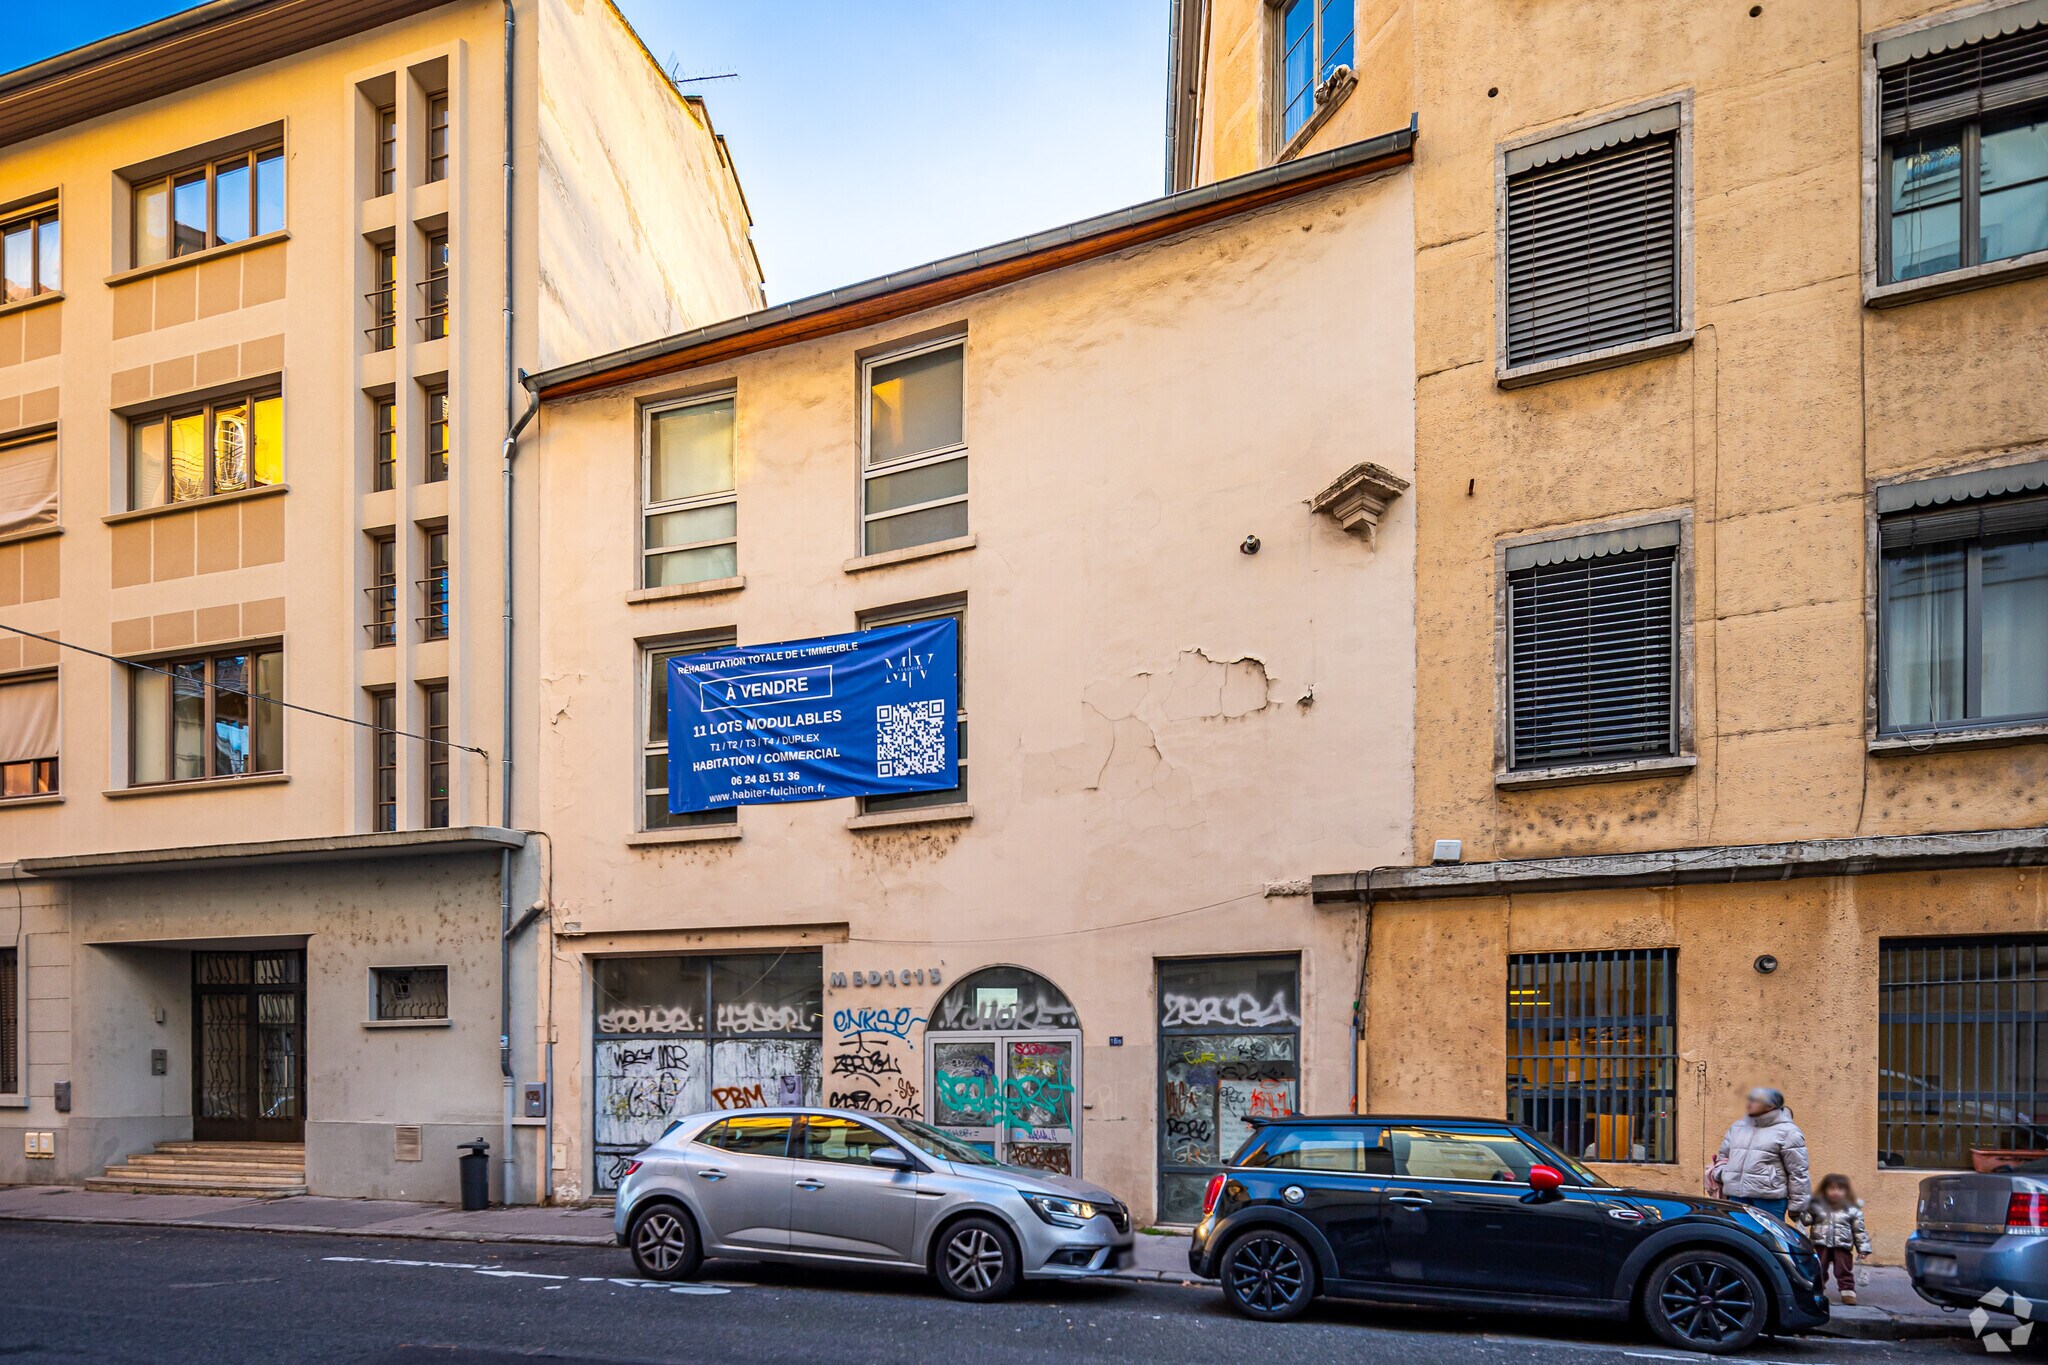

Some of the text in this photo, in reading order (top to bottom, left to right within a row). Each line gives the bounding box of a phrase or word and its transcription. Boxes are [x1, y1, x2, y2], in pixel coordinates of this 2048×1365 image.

[677, 641, 859, 675] RÉHABILITATION TOTALE DE L'IMMEUBLE
[725, 676, 809, 701] À VENDRE
[693, 709, 842, 738] 11 LOTS MODULABLES
[710, 742, 721, 752] T1
[727, 740, 738, 750] T2
[745, 738, 757, 748] T3
[762, 736, 774, 746] T4
[782, 733, 820, 745] DUPLEX
[693, 754, 755, 772] HABITATION
[764, 747, 841, 763] COMMERCIAL
[731, 771, 800, 786] 06 24 81 51 36
[709, 783, 826, 803] www.habiter-fulchiron.fr
[829, 967, 942, 988] MEDICIS
[711, 1083, 768, 1110] PBM
